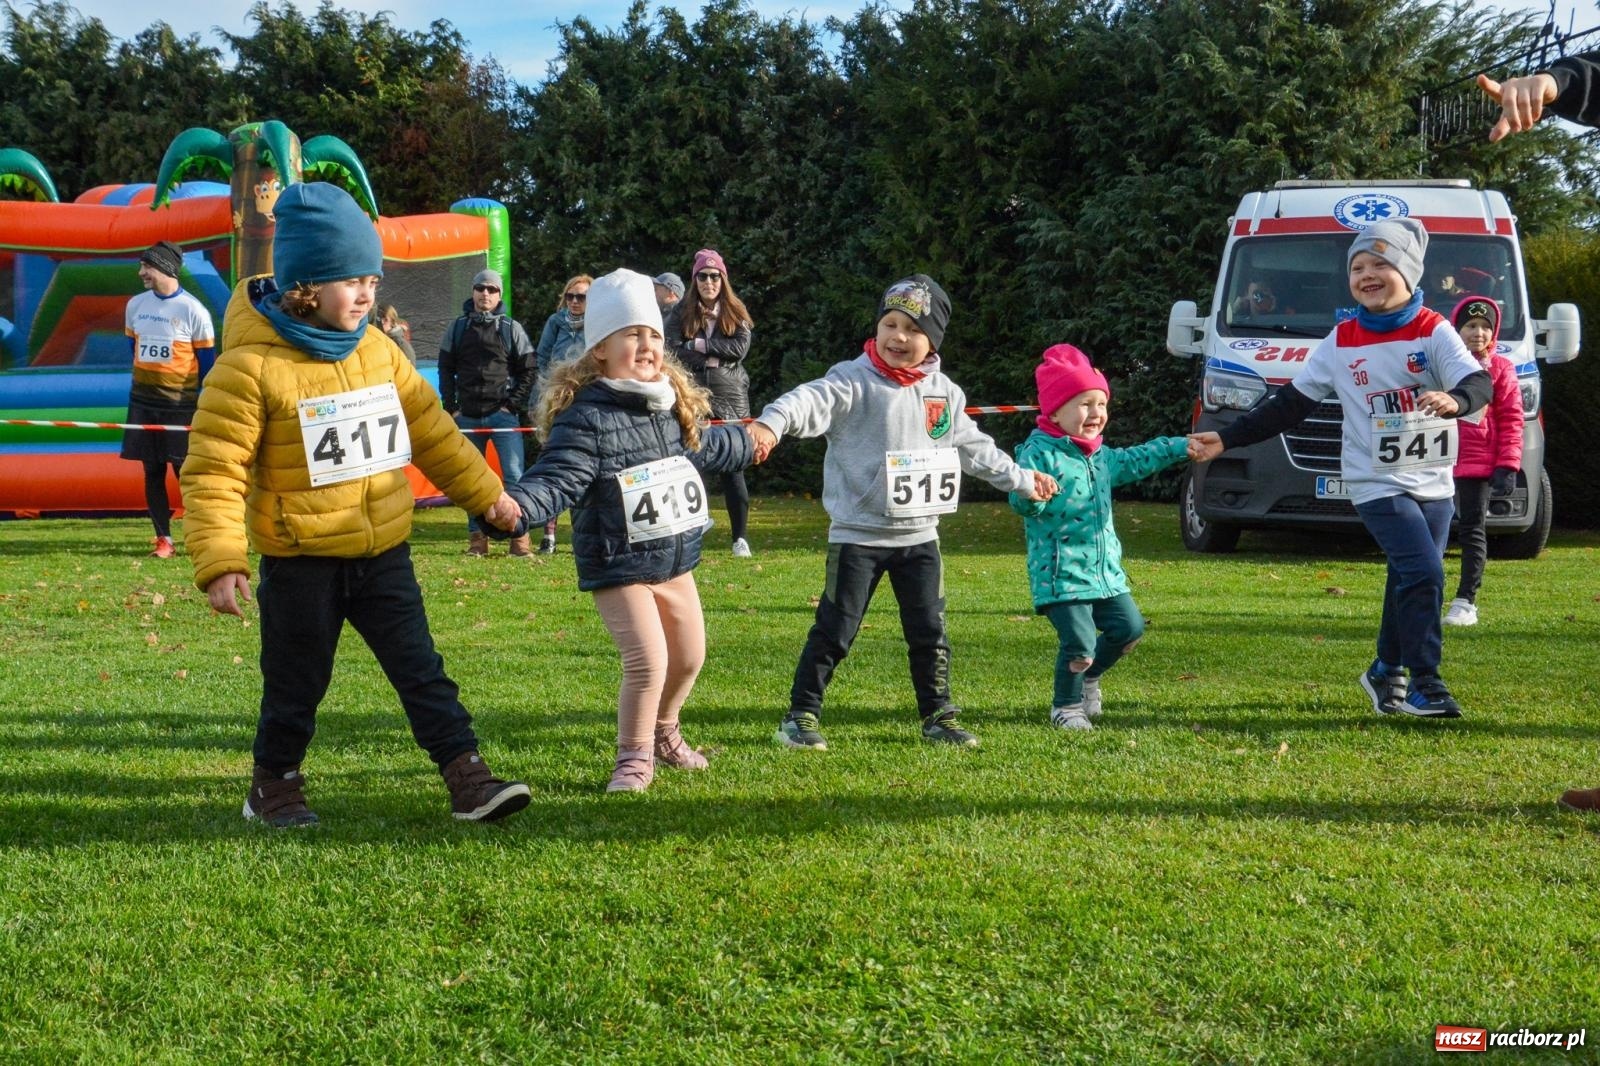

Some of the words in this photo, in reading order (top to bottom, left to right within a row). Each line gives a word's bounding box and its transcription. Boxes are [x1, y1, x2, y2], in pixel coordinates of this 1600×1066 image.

[139, 344, 170, 359] 768
[1352, 370, 1369, 386] 38
[313, 413, 400, 466] 417
[1378, 429, 1449, 464] 541
[631, 480, 703, 526] 419
[892, 471, 957, 506] 515
[1326, 479, 1349, 495] CT
